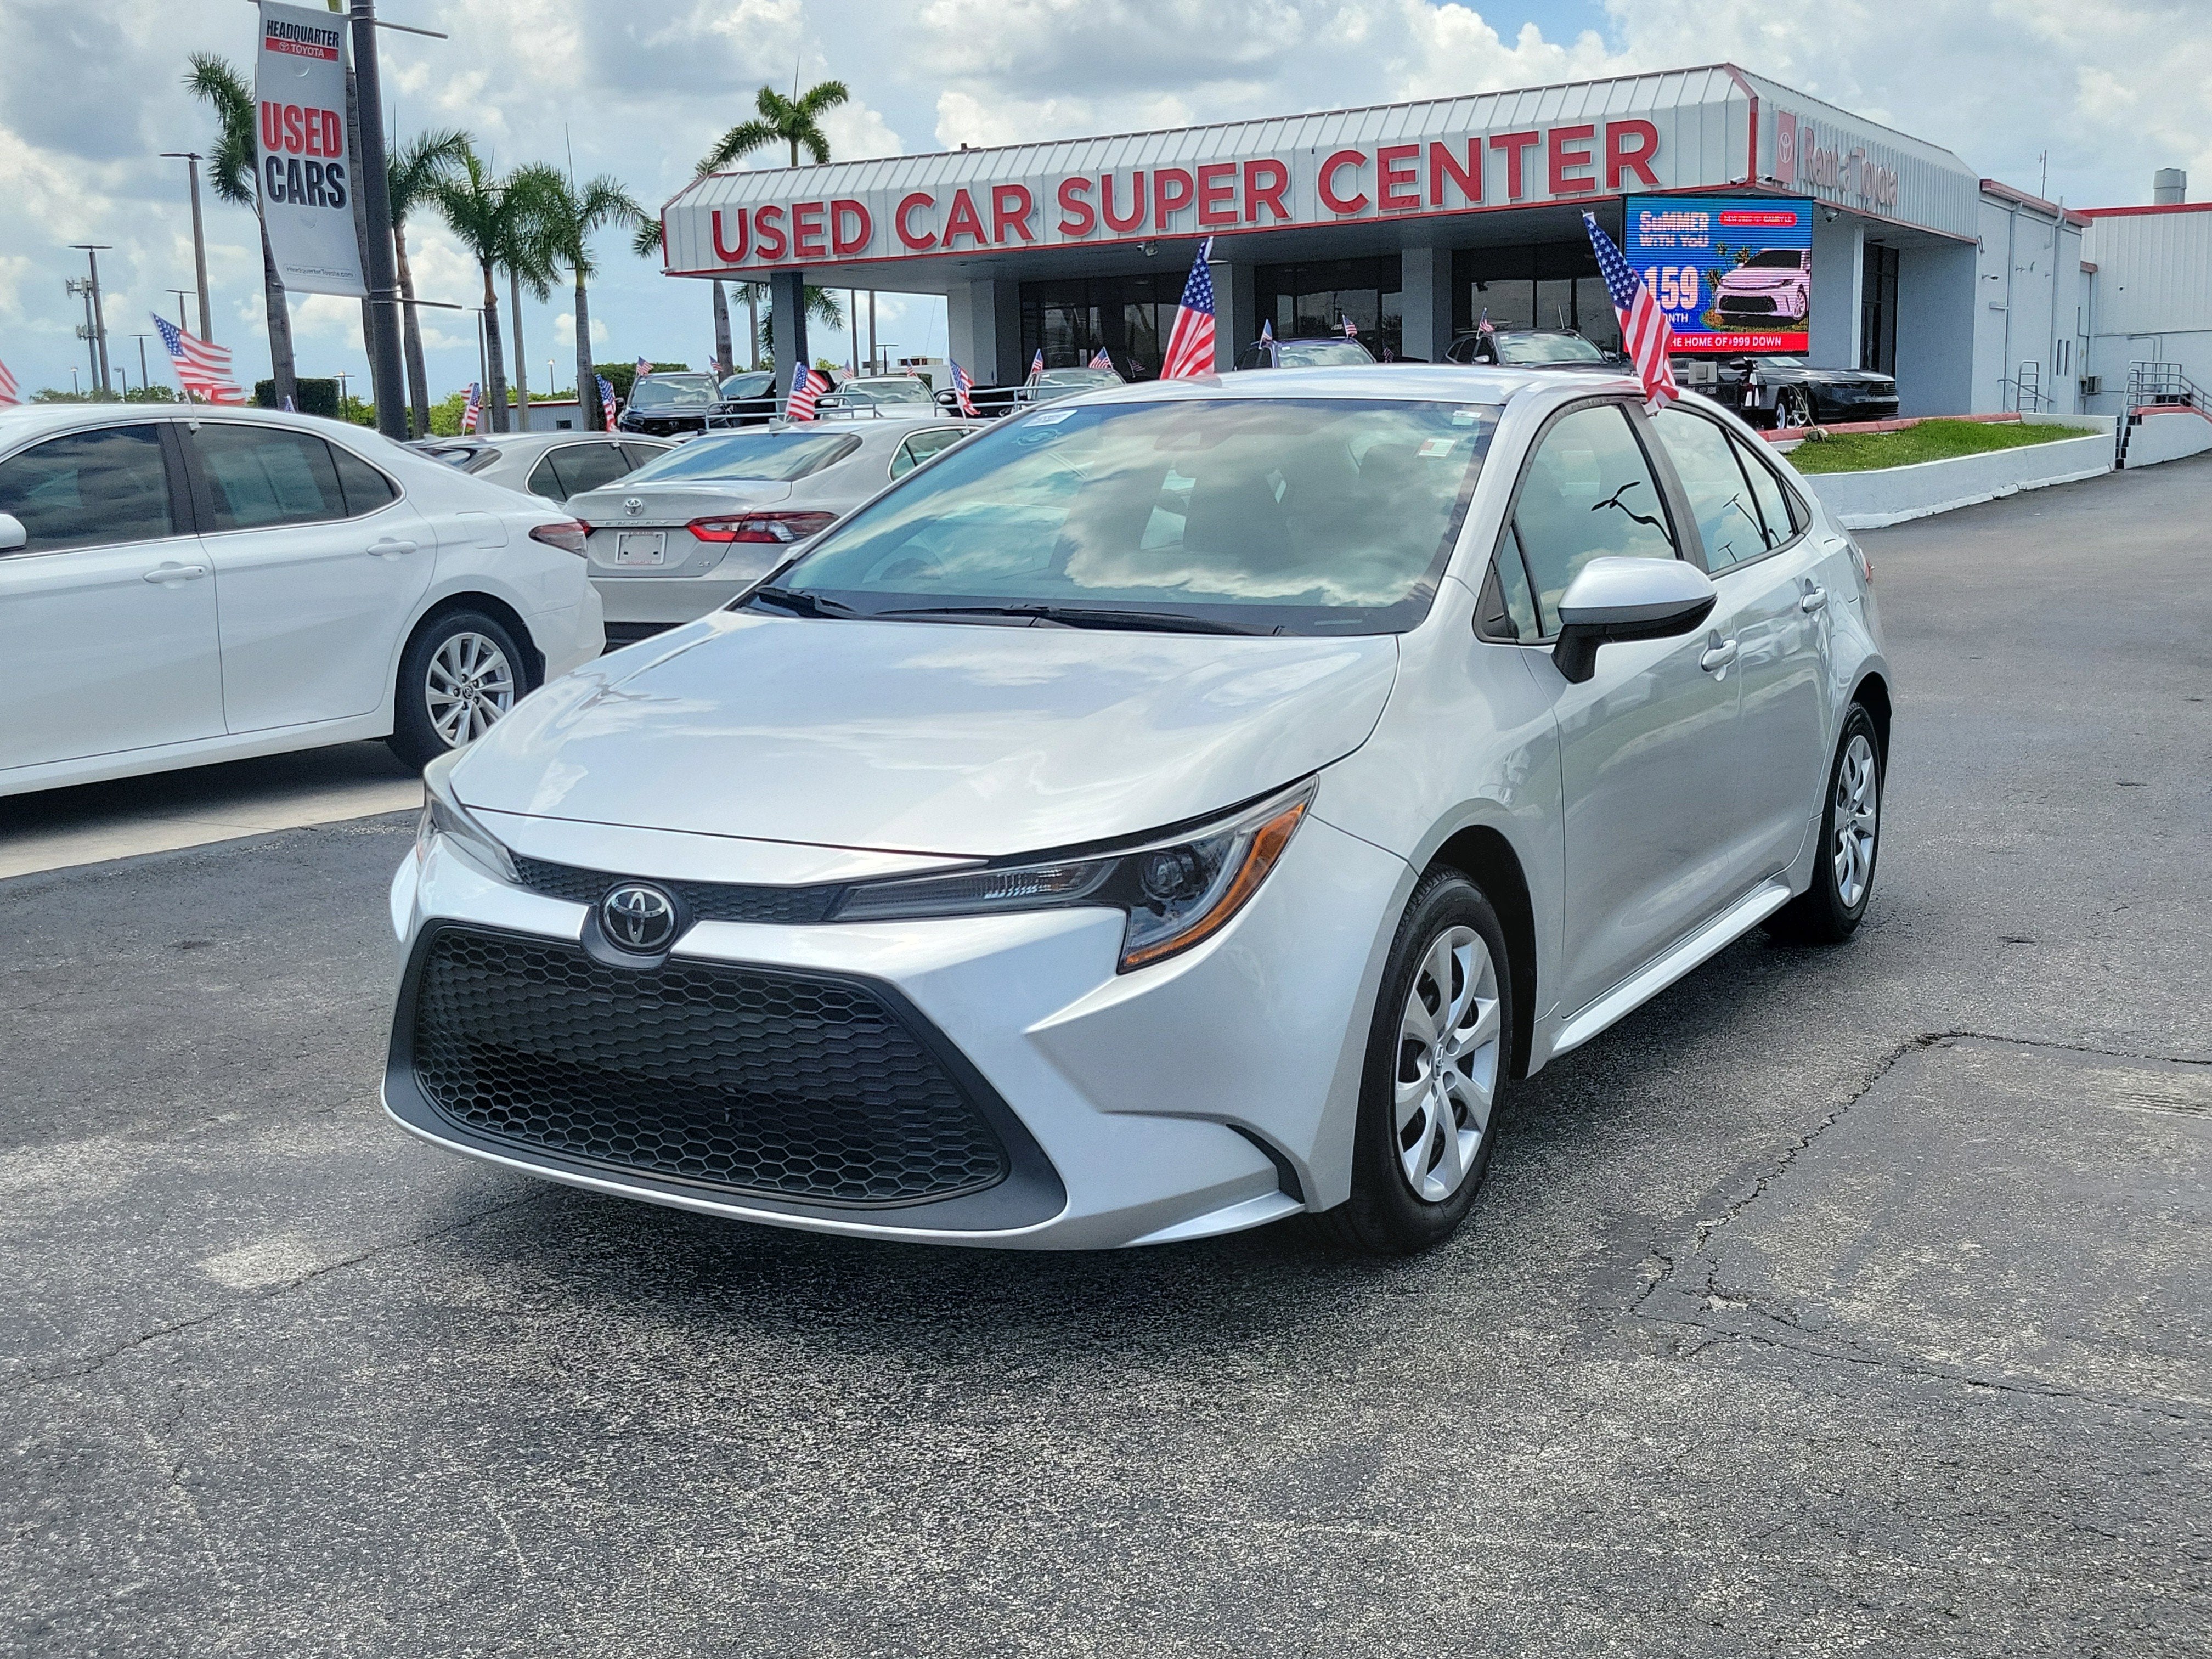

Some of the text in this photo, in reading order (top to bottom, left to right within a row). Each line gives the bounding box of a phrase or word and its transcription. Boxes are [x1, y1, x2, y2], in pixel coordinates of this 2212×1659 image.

[267, 20, 339, 48] HEADQUARTER
[291, 44, 325, 58] TOYOTA
[262, 101, 343, 159] USED
[266, 155, 347, 210] CARS
[712, 119, 1660, 263] USED CAR SUPER CENTER
[1804, 127, 1838, 188] Rent
[1850, 146, 1898, 212] Toyota
[1644, 266, 1699, 310] 159
[1666, 313, 1688, 323] NTH
[1685, 337, 1711, 347] HOME
[1715, 337, 1728, 346] OF
[1753, 336, 1781, 346] DOWN
